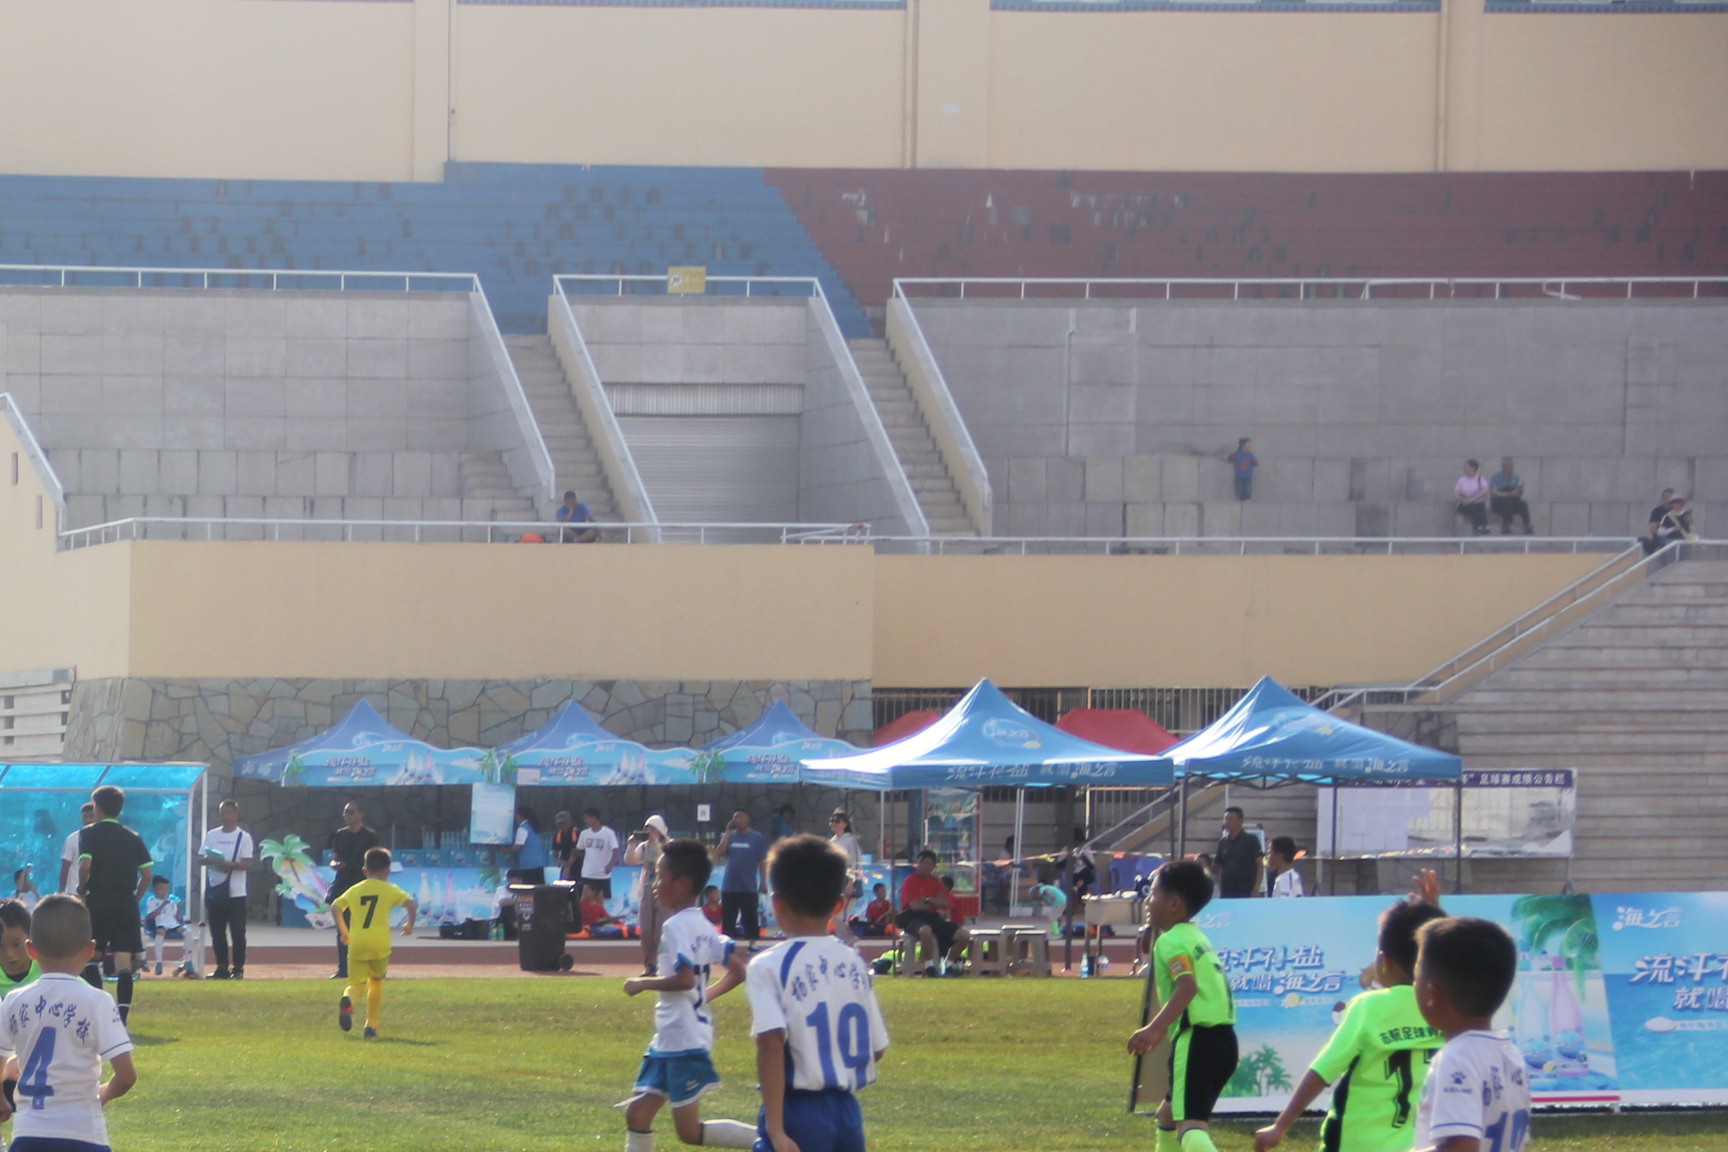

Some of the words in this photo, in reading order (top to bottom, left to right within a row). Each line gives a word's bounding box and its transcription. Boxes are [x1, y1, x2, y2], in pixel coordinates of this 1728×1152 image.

[359, 895, 380, 929] 7
[1612, 905, 1683, 932] 海之言
[17, 1025, 57, 1110] 4
